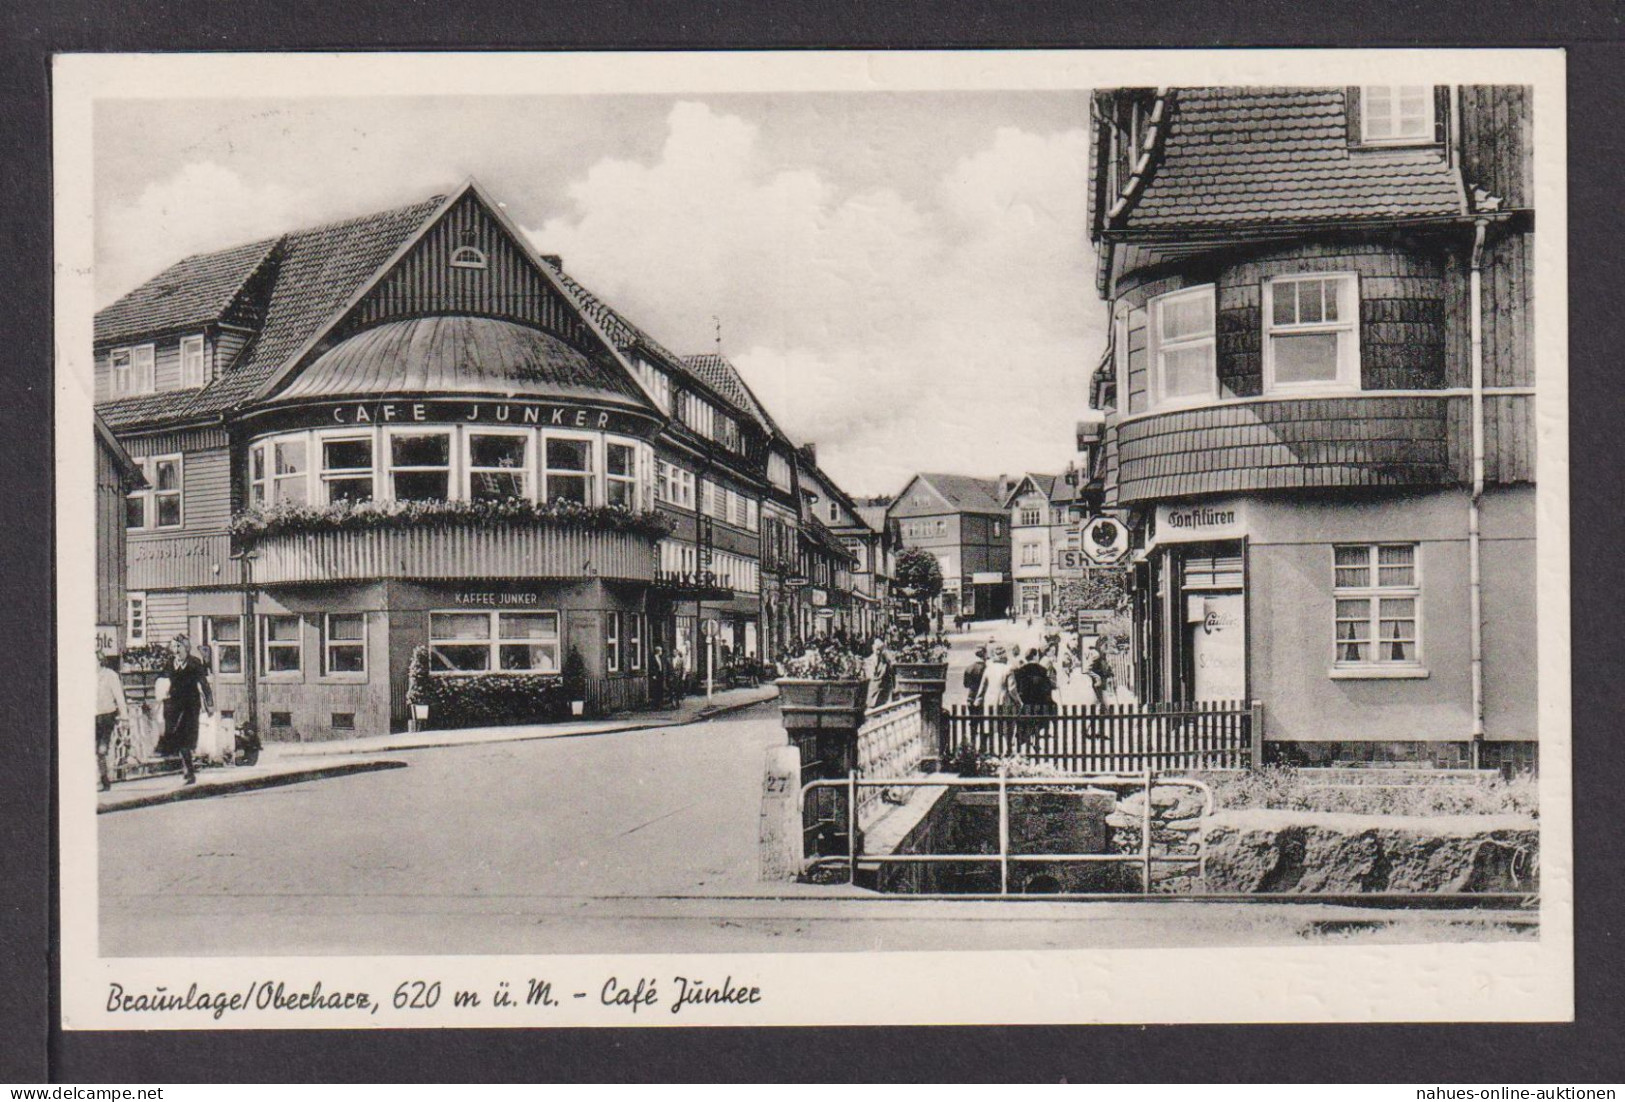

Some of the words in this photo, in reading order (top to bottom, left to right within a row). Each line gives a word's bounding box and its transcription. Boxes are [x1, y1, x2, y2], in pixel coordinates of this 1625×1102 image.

[333, 403, 427, 424] CAFE
[466, 403, 610, 429] JUNKER
[455, 593, 495, 606] KAFFEE
[498, 593, 538, 606] JUNKER
[393, 980, 442, 1010] 620
[454, 990, 481, 1008] m
[493, 981, 518, 1008] ü.
[526, 977, 559, 1007] M.
[601, 976, 659, 1014] Café
